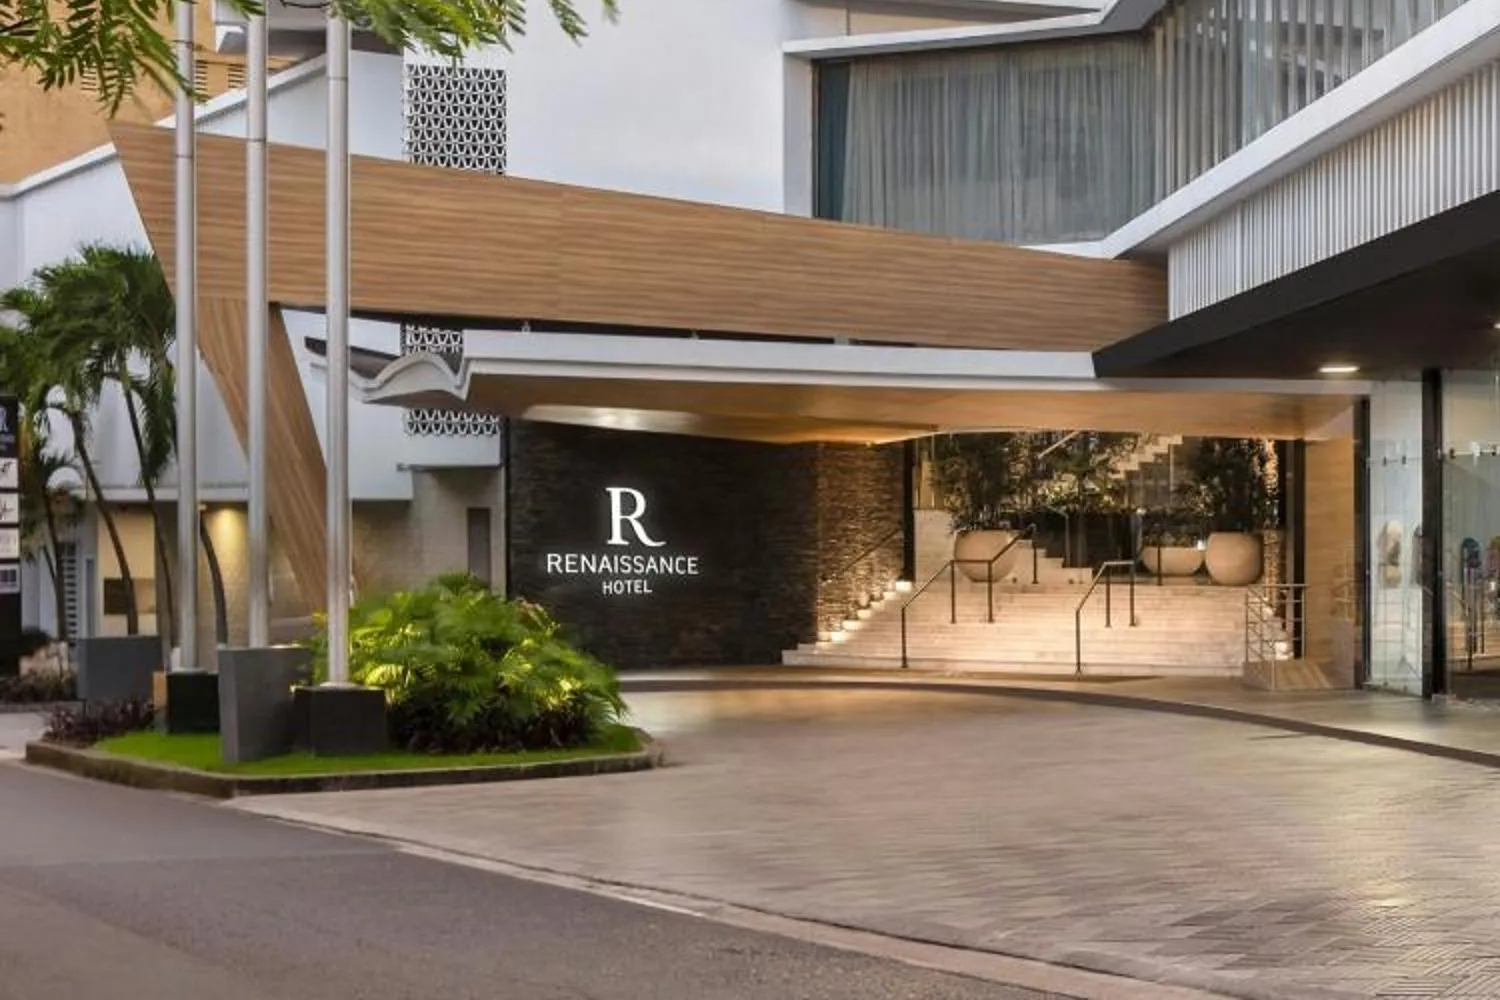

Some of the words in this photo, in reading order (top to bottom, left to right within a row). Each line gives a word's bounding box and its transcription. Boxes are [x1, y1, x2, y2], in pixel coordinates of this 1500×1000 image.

[605, 487, 666, 547] R
[547, 553, 699, 575] RENAISSANCE
[602, 578, 653, 595] HOTEL
